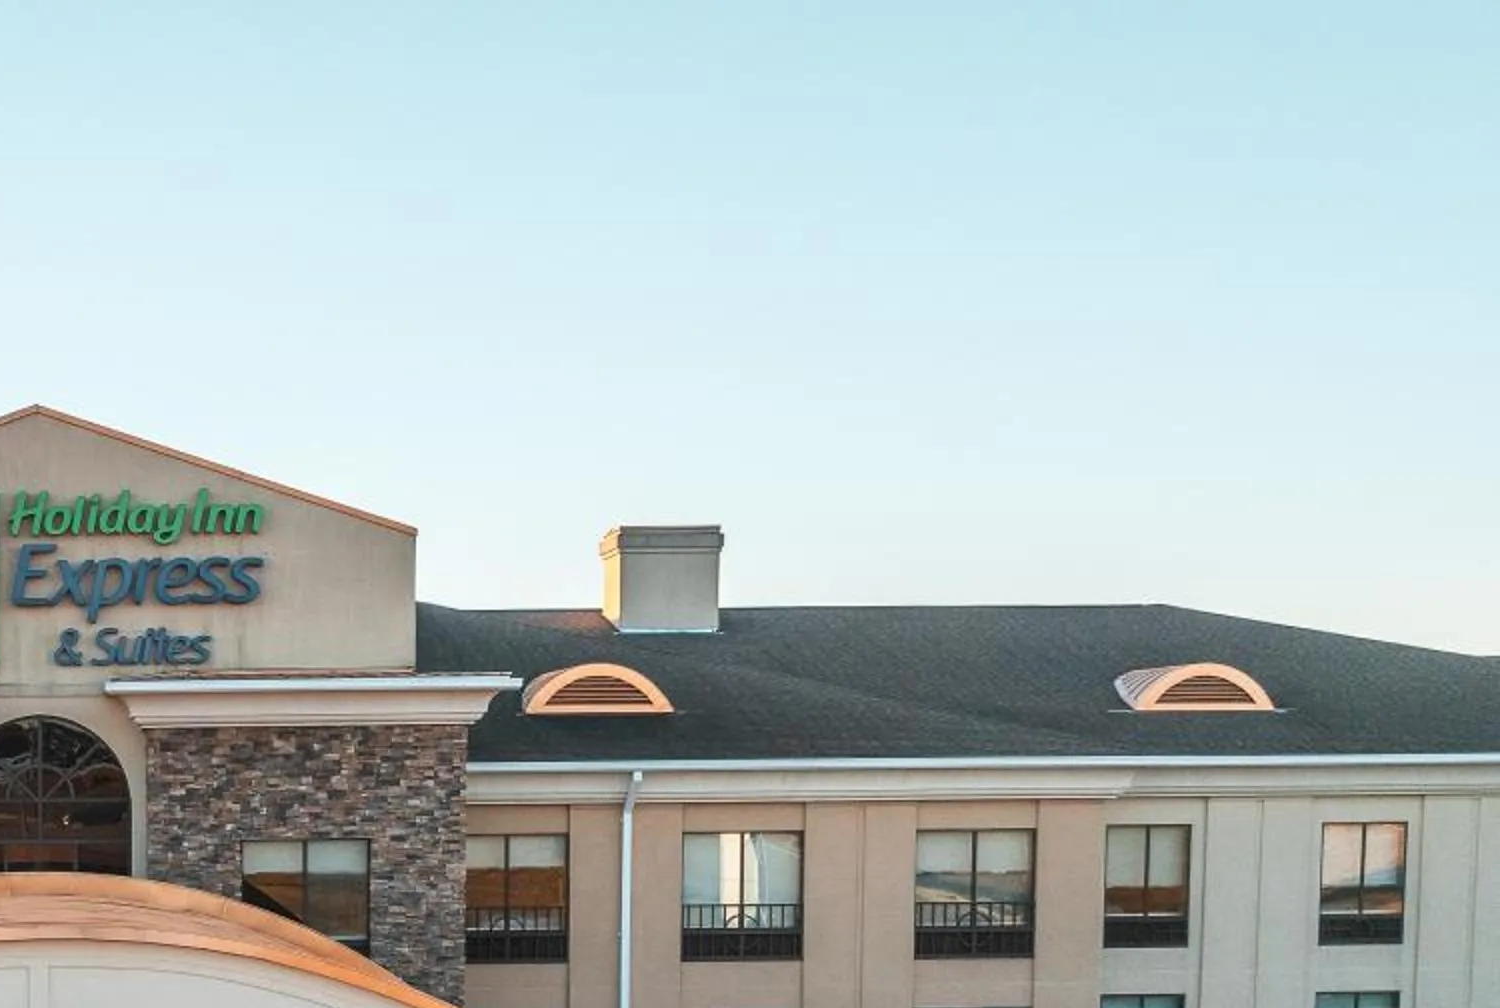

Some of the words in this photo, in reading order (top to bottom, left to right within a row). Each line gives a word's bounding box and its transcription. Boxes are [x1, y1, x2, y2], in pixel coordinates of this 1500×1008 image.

[8, 489, 187, 545] Holiday
[191, 488, 263, 536] Inn
[11, 543, 264, 624] Express
[54, 628, 84, 667] &
[91, 627, 213, 667] Suites
